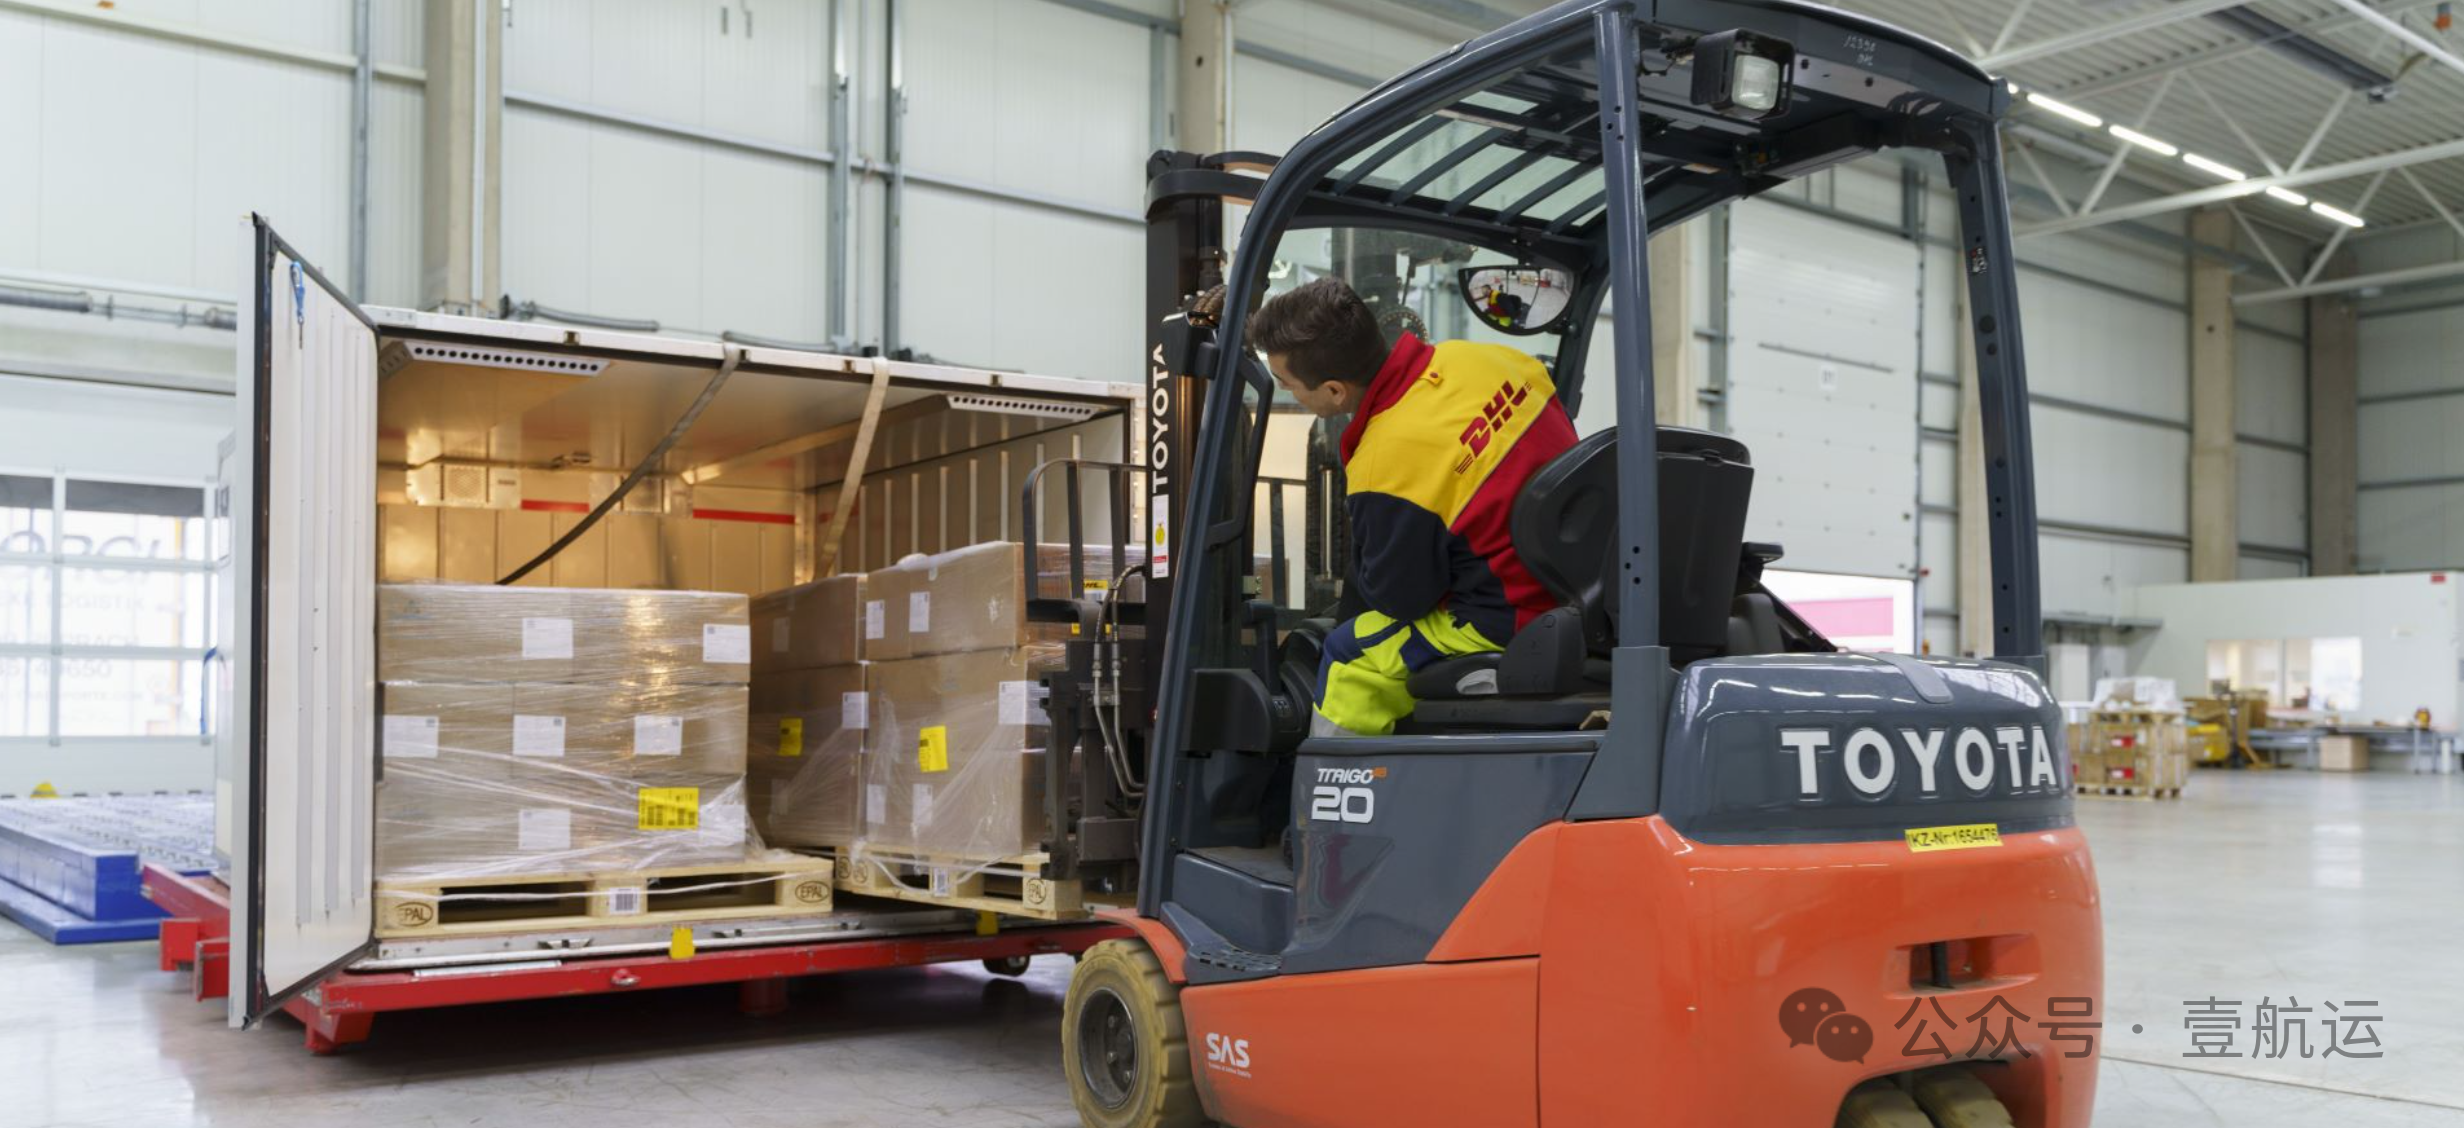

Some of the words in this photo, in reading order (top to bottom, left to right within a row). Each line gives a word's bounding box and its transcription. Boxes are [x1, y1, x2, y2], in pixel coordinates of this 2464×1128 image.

[1152, 343, 1169, 494] TOYOTA
[1458, 380, 1529, 459] DHL
[1780, 727, 2058, 794] TOYOTA
[1311, 786, 1374, 824] 20
[1206, 1032, 1250, 1068] SAS
